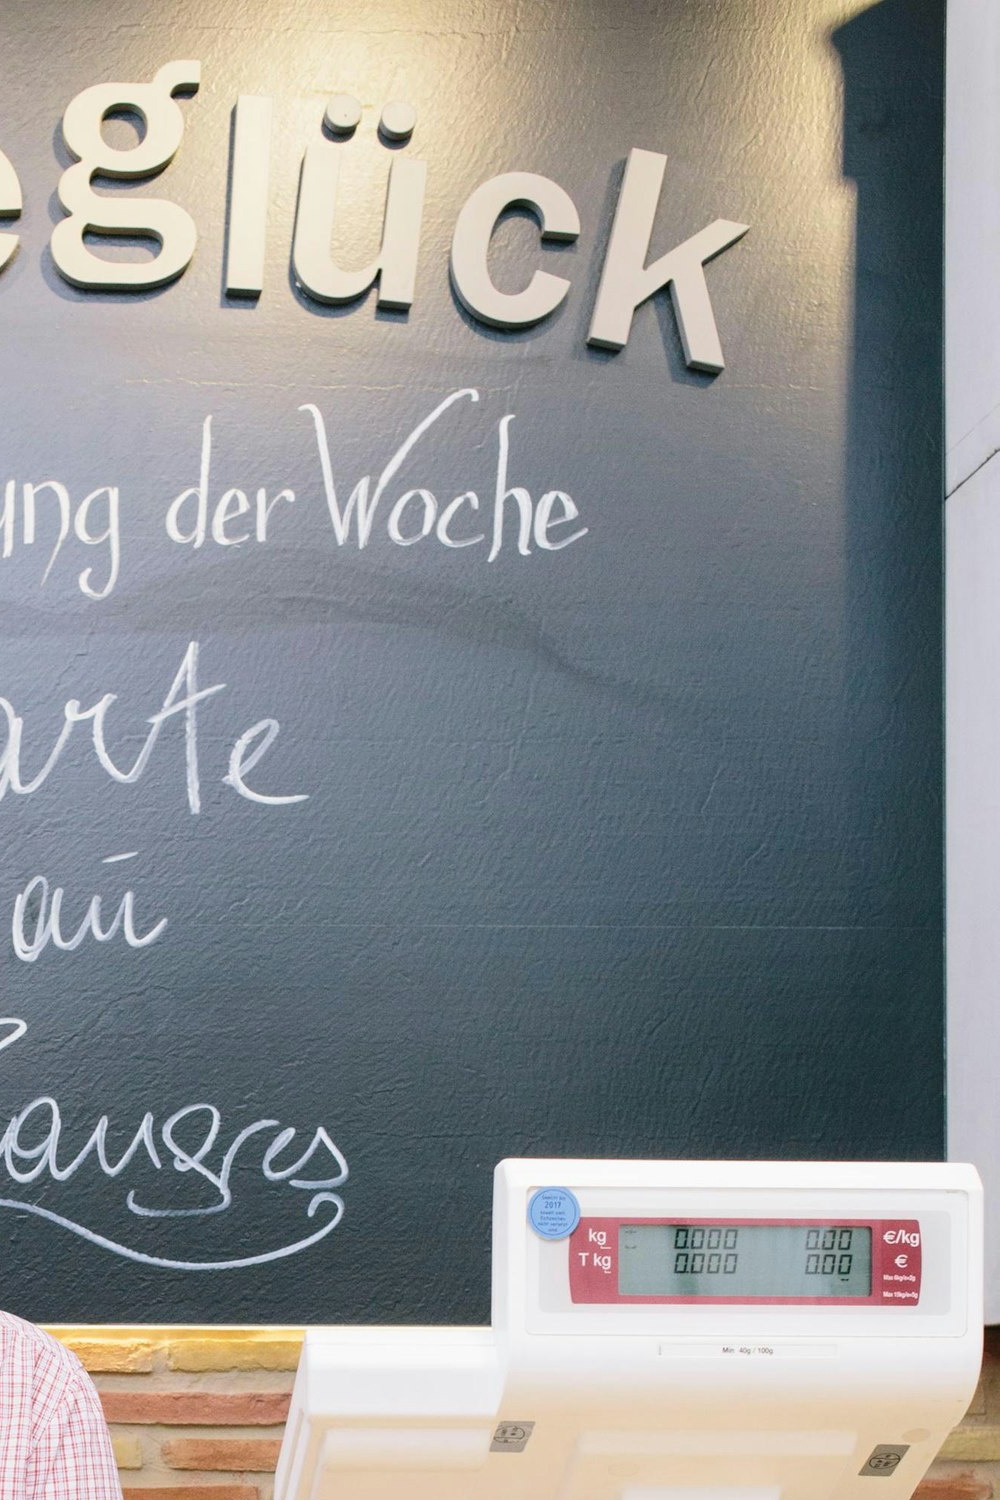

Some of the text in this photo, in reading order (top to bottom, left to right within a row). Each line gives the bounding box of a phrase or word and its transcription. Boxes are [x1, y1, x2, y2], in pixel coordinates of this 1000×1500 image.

[166, 413, 296, 552] der
[298, 388, 589, 563] Woche
[544, 1201, 562, 1209] 2017
[588, 1228, 919, 1250] kg 0.000 0.00 €/kg
[578, 1252, 908, 1275] T kg 0.000 0.00 €
